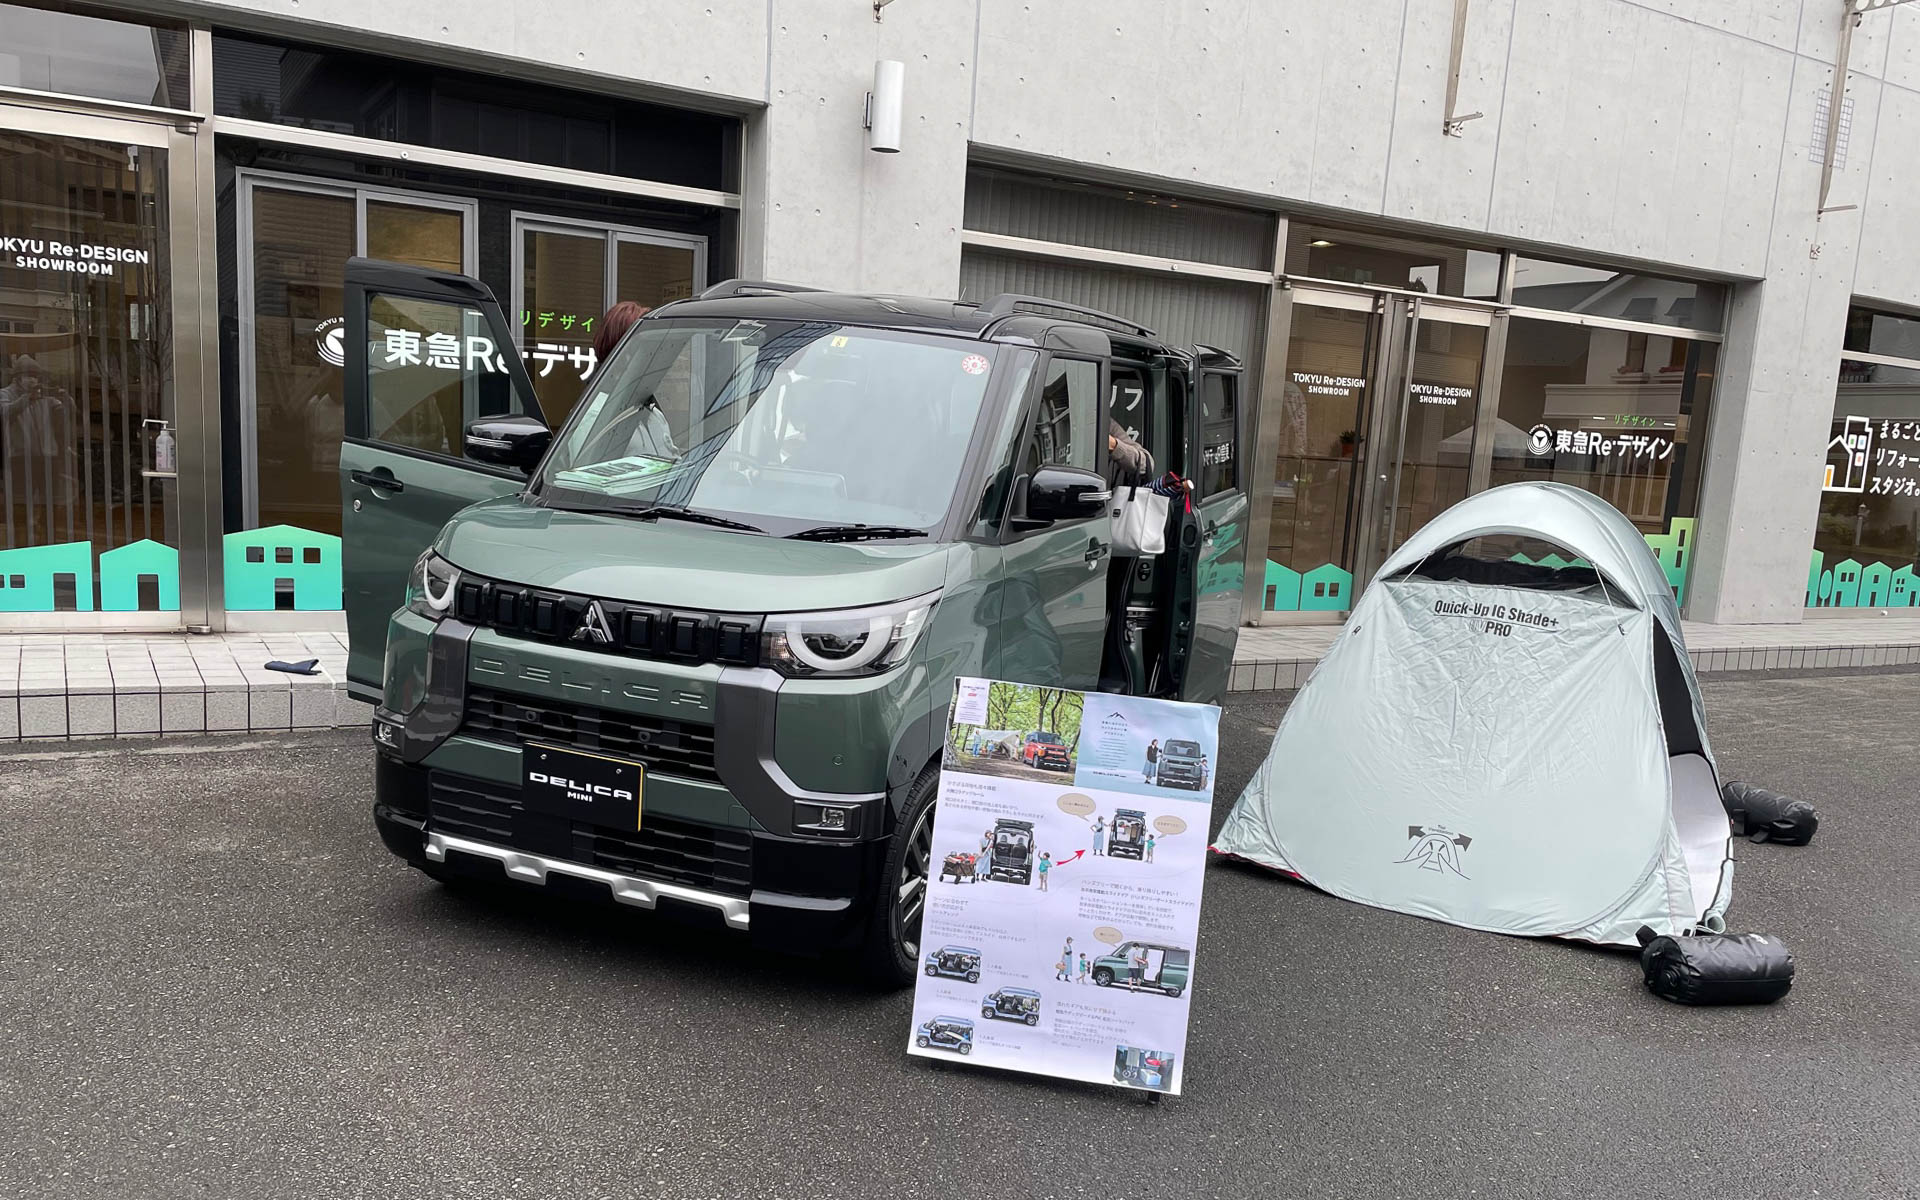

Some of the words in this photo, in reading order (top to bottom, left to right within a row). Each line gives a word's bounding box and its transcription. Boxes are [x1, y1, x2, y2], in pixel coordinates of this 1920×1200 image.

[0, 237, 44, 254] KYU
[16, 255, 113, 276] SHOWROOM
[315, 317, 337, 332] TOKYU
[1293, 372, 1322, 385] TOKYU
[1308, 385, 1350, 396] SHOWROOM
[1410, 384, 1432, 394] OKYU
[1419, 395, 1457, 405] SHOWROOM
[1876, 447, 1920, 468] リフォー
[1434, 600, 1490, 617] Quick-Up
[1492, 604, 1506, 619] IG
[1508, 607, 1559, 627] Shade+
[1485, 621, 1512, 637] PRO
[474, 657, 709, 710] DELICA
[529, 771, 632, 801] DELICA
[567, 791, 593, 802] MINI
